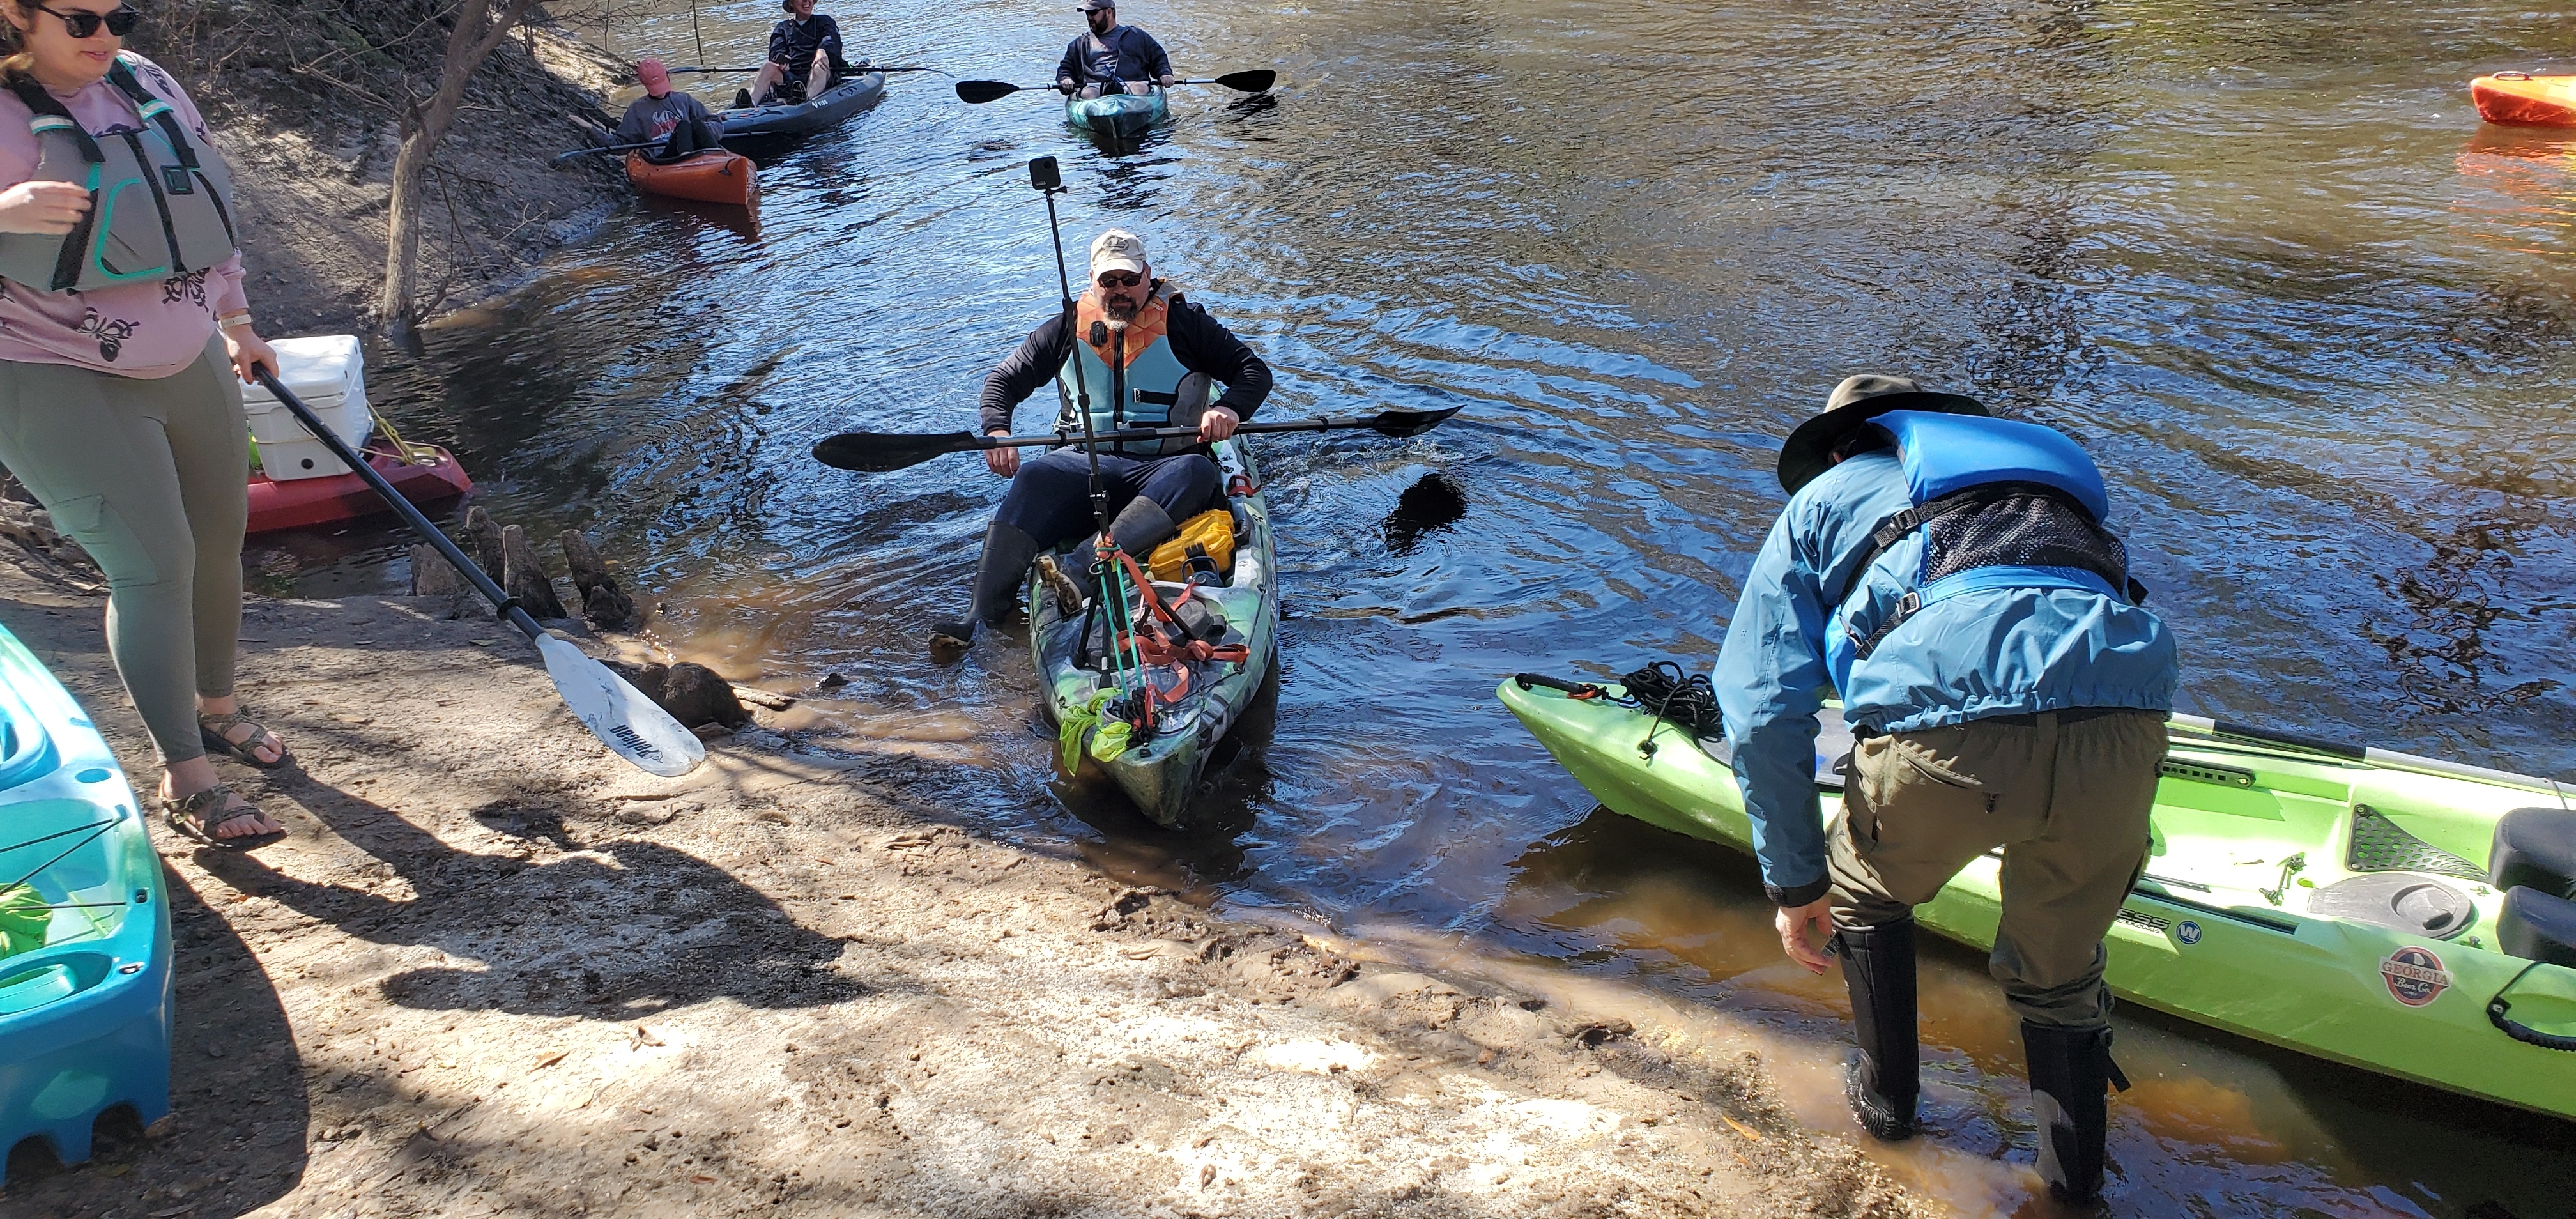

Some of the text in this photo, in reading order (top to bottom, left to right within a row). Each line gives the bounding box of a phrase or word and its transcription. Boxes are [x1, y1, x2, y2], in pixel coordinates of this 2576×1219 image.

[2115, 907, 2171, 930] ESS
[2116, 917, 2164, 934] STEMS
[2382, 962, 2449, 985] GEORGIA
[2395, 977, 2432, 993] Beer Co.
